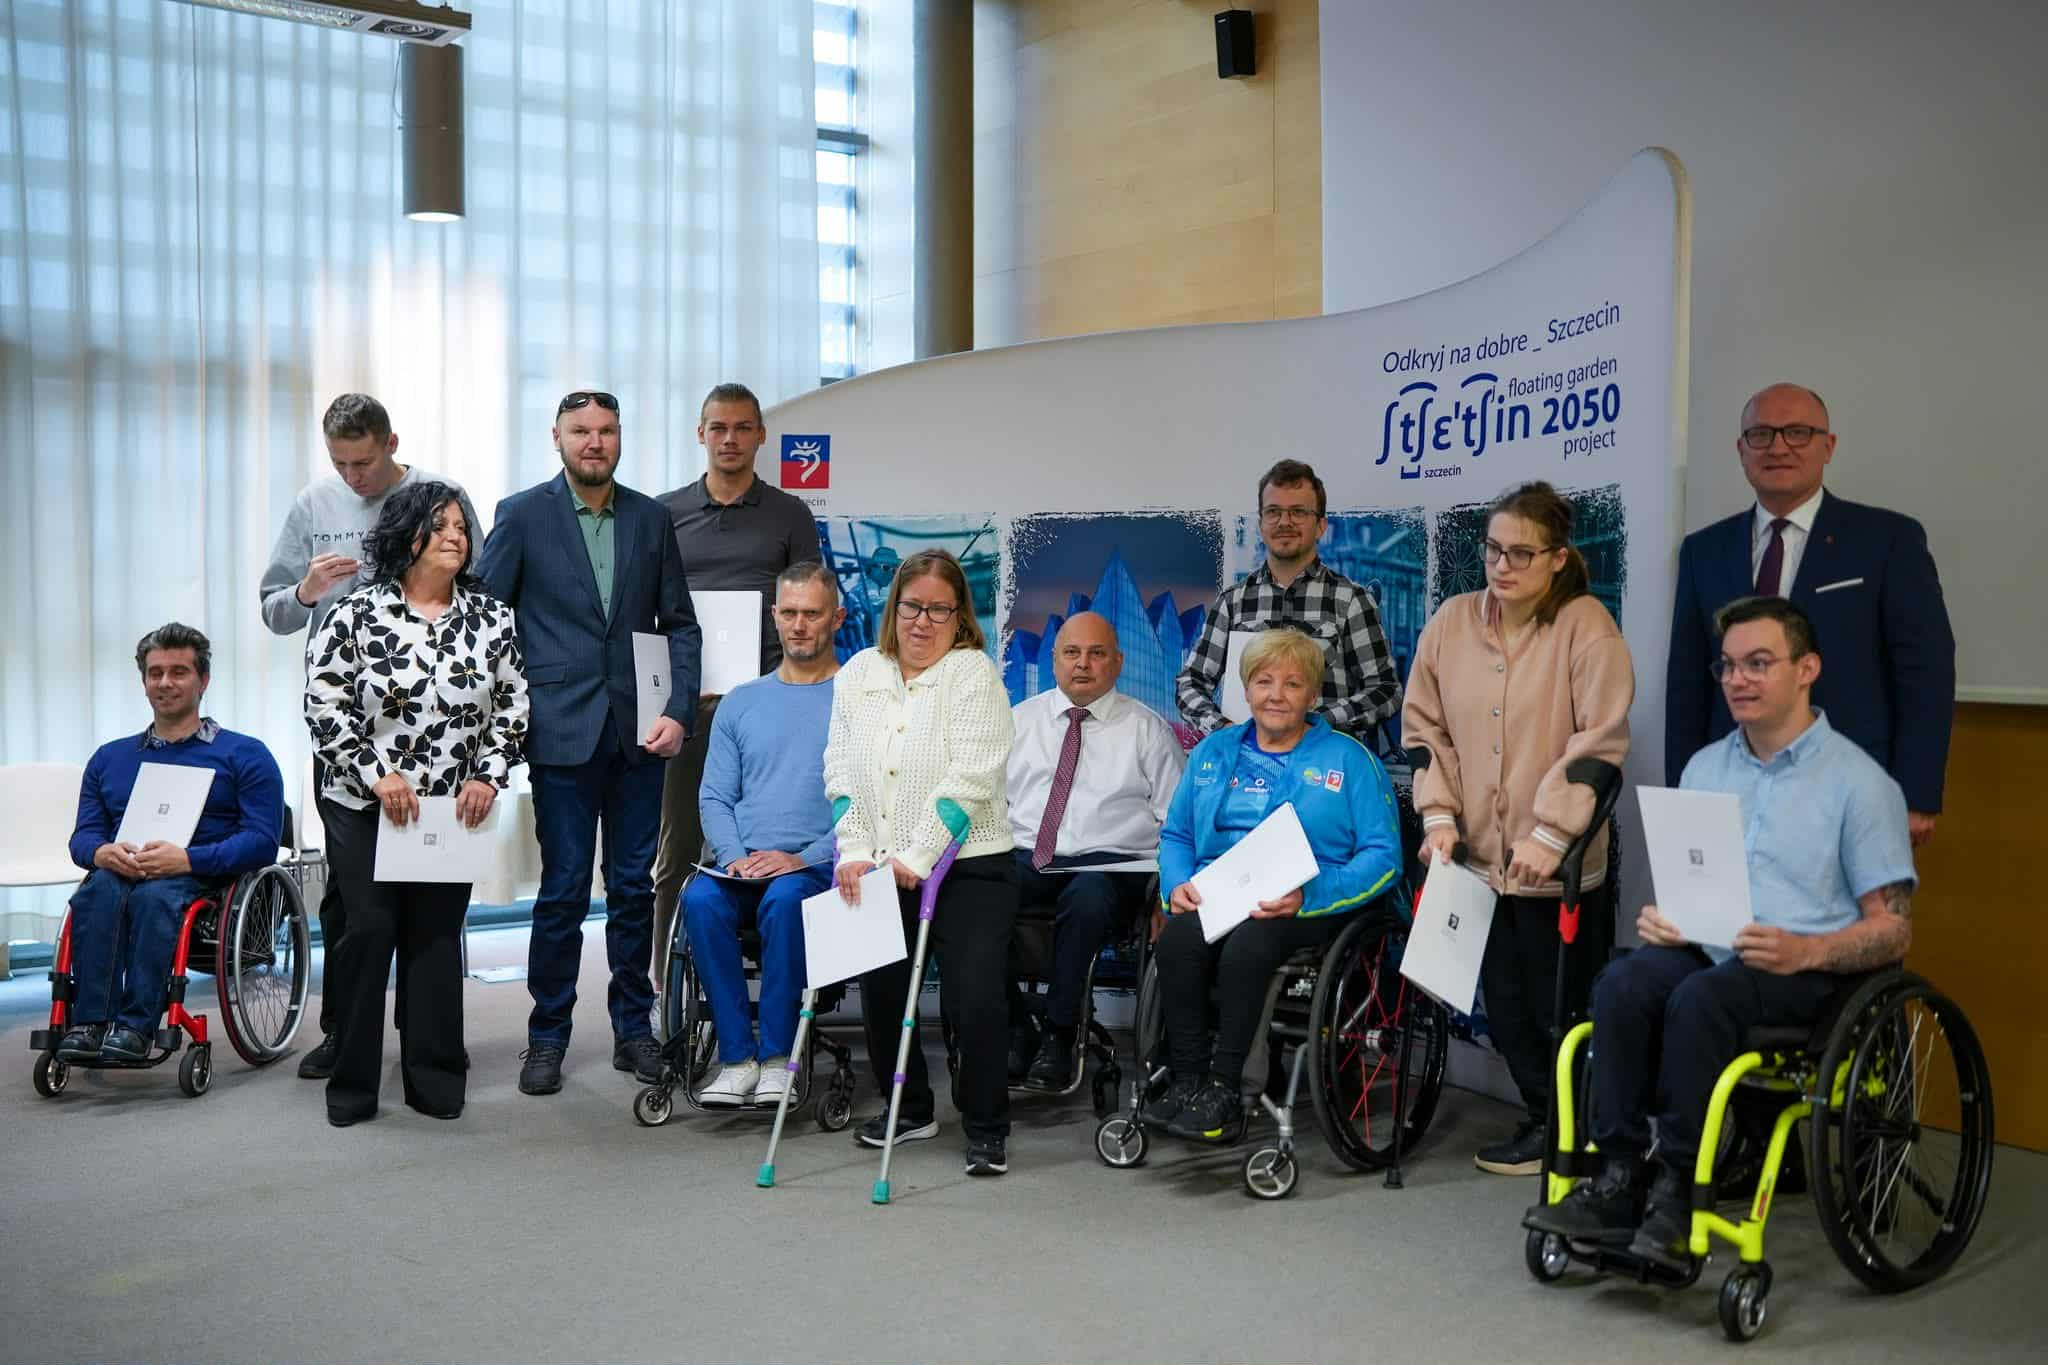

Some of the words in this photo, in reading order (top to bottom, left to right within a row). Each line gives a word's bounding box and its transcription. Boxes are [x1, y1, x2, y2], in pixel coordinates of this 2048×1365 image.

[1383, 344, 1445, 374] Odkryj
[1450, 346, 1471, 366] na
[1476, 333, 1529, 361] dobre
[1547, 301, 1620, 344] Szczecin
[1508, 371, 1564, 399] floating
[1567, 356, 1617, 393] garden
[1541, 383, 1620, 437] 2050
[1564, 428, 1617, 461] project
[1424, 464, 1462, 480] szczecin
[313, 531, 365, 542] TOMMY
